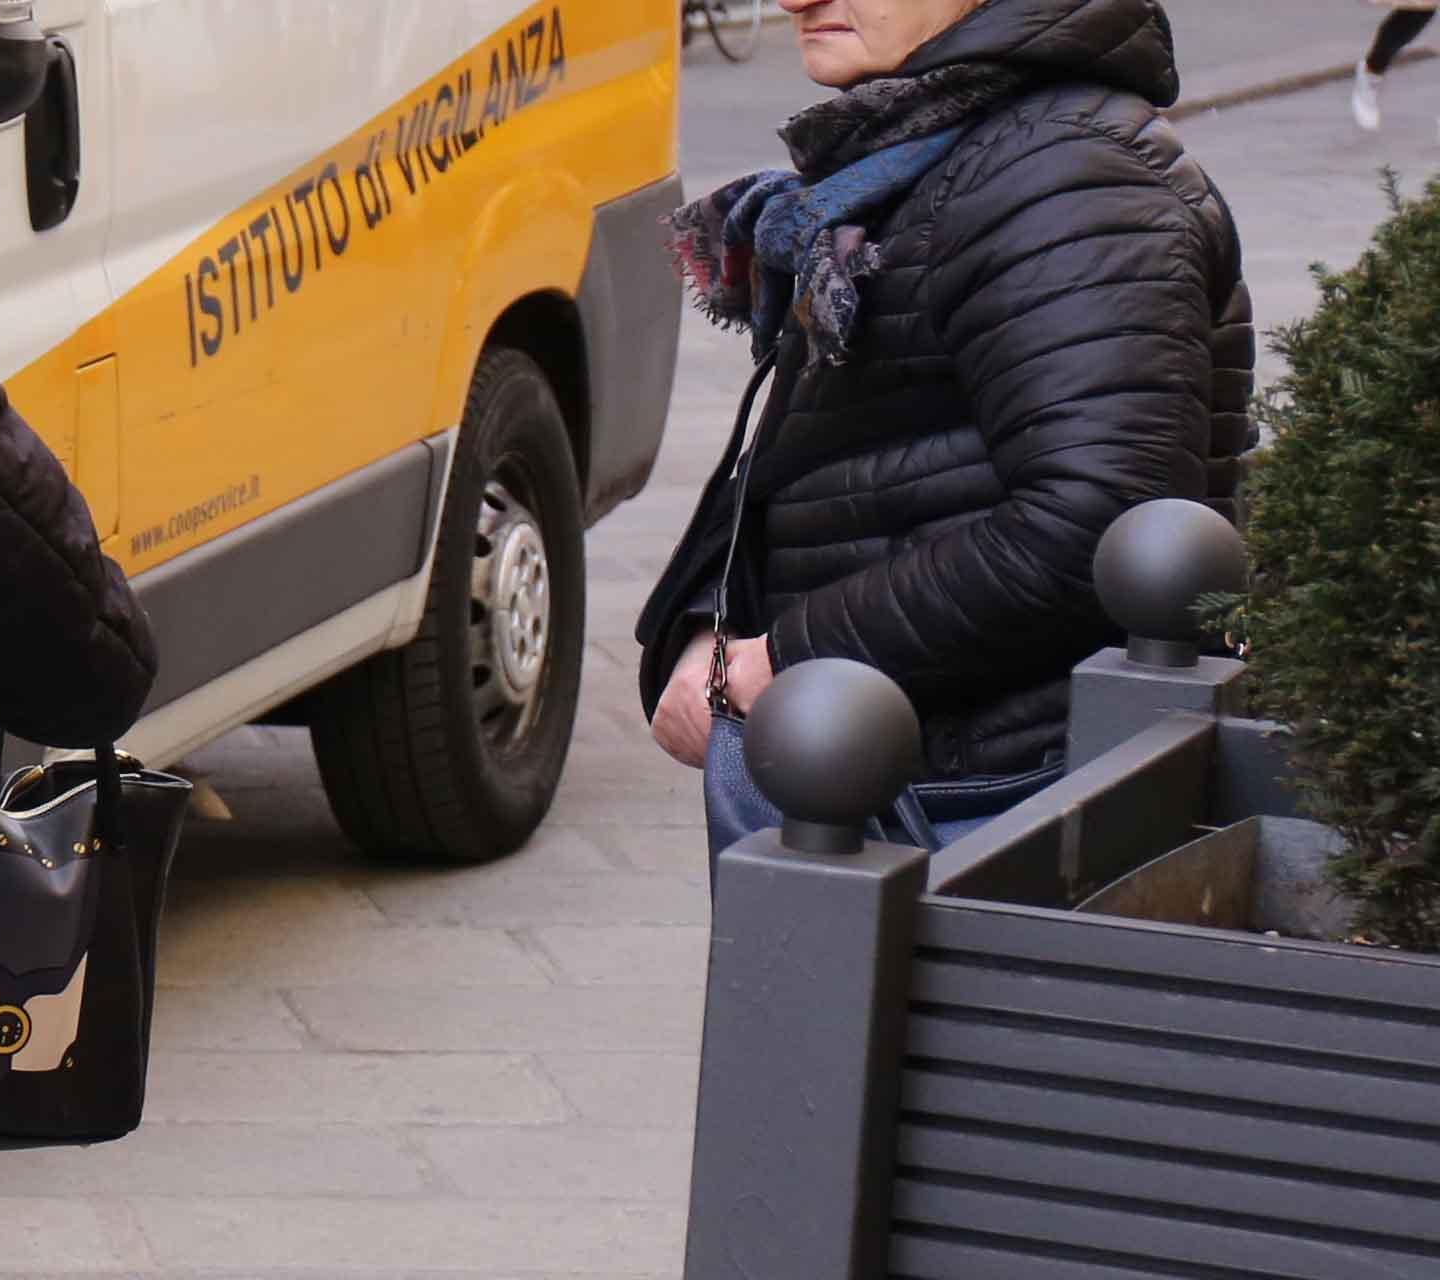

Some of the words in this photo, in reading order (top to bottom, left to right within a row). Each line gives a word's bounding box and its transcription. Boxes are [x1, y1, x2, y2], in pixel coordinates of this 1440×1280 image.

[184, 161, 351, 369] ISTITUTO
[353, 128, 392, 231] di
[394, 4, 568, 196] VIGILANZA
[130, 473, 261, 558] www.coopservice.it
